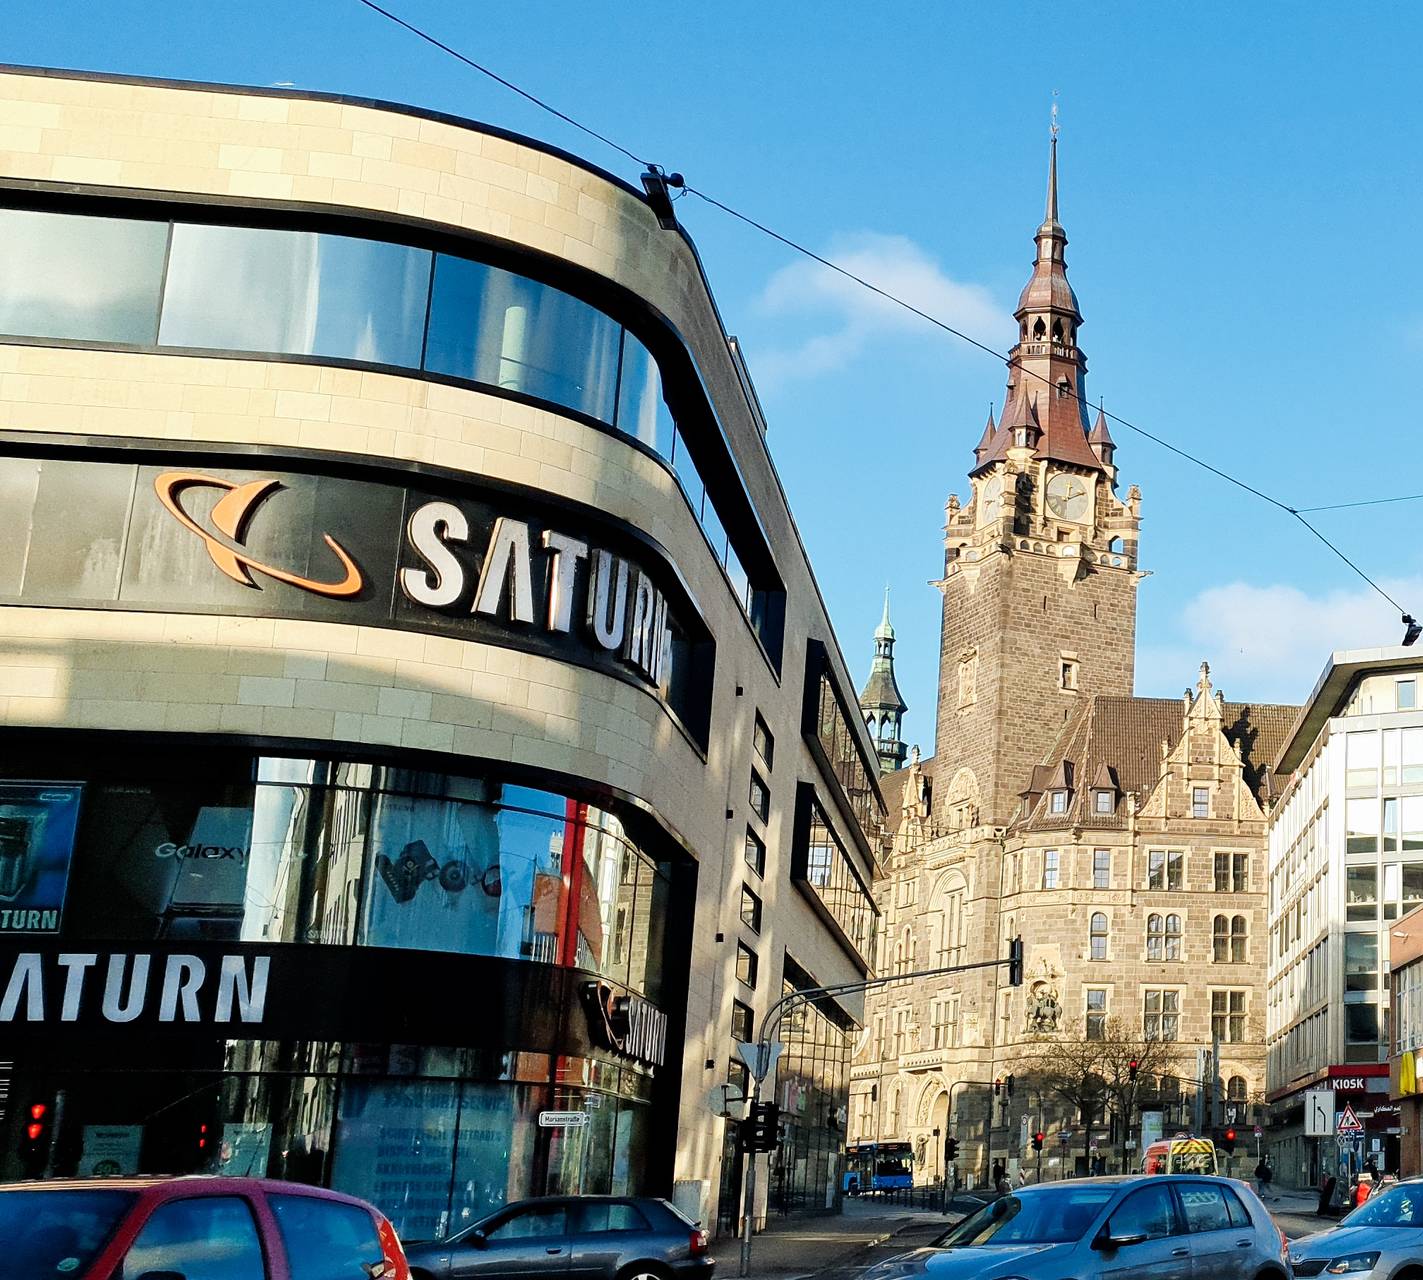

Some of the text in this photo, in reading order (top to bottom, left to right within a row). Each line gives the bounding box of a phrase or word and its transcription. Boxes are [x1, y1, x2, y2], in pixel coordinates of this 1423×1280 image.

[400, 502, 668, 688] SATURN
[155, 842, 250, 868] Galaxy
[1, 909, 58, 930] TURN
[0, 953, 271, 1023] ATURN
[1332, 1078, 1364, 1090] KIOSK
